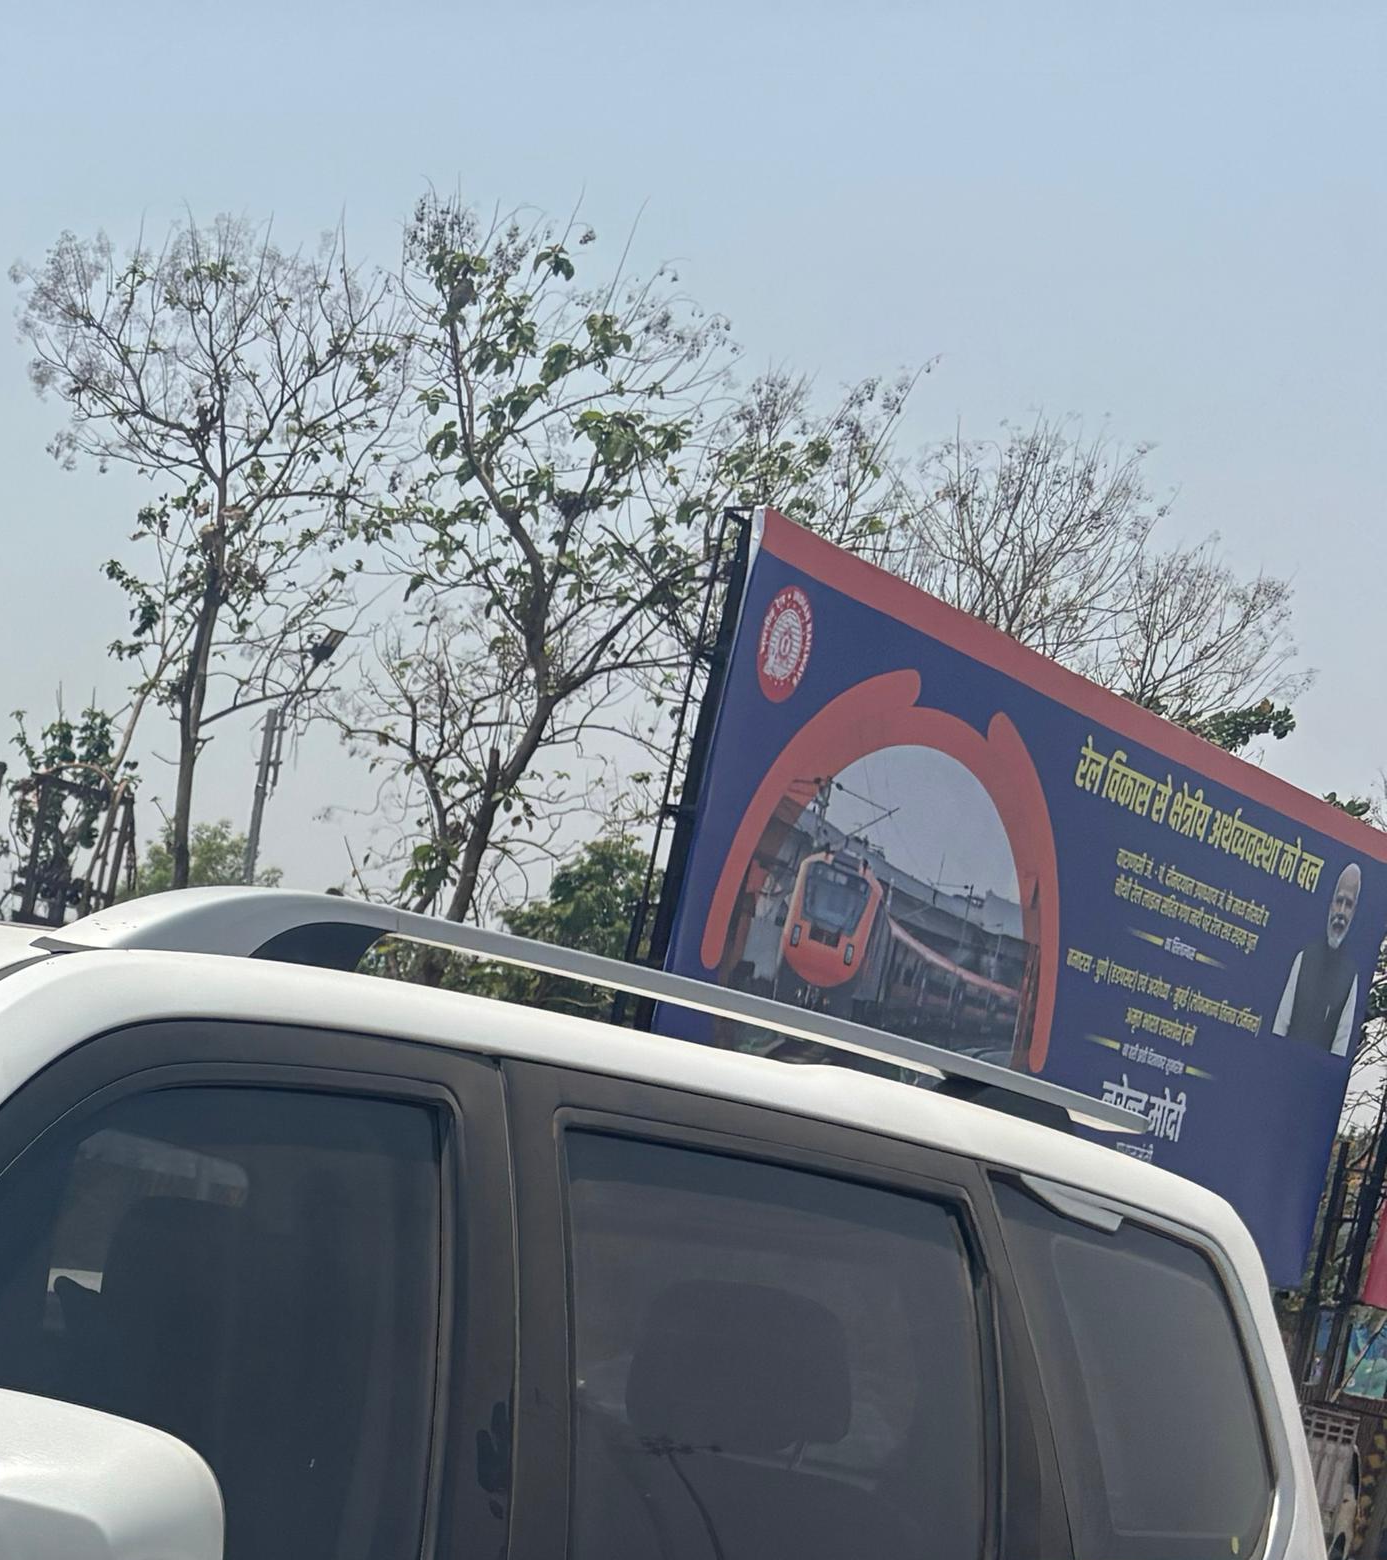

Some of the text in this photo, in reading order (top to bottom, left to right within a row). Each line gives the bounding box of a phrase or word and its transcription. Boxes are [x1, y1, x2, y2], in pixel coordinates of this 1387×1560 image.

[1074, 735, 1107, 795] रेल
[1101, 750, 1156, 817] विकास
[1151, 774, 1173, 824] से
[1278, 837, 1302, 884] को
[1297, 851, 1325, 893] बल
[1147, 1087, 1187, 1142] मोदी
